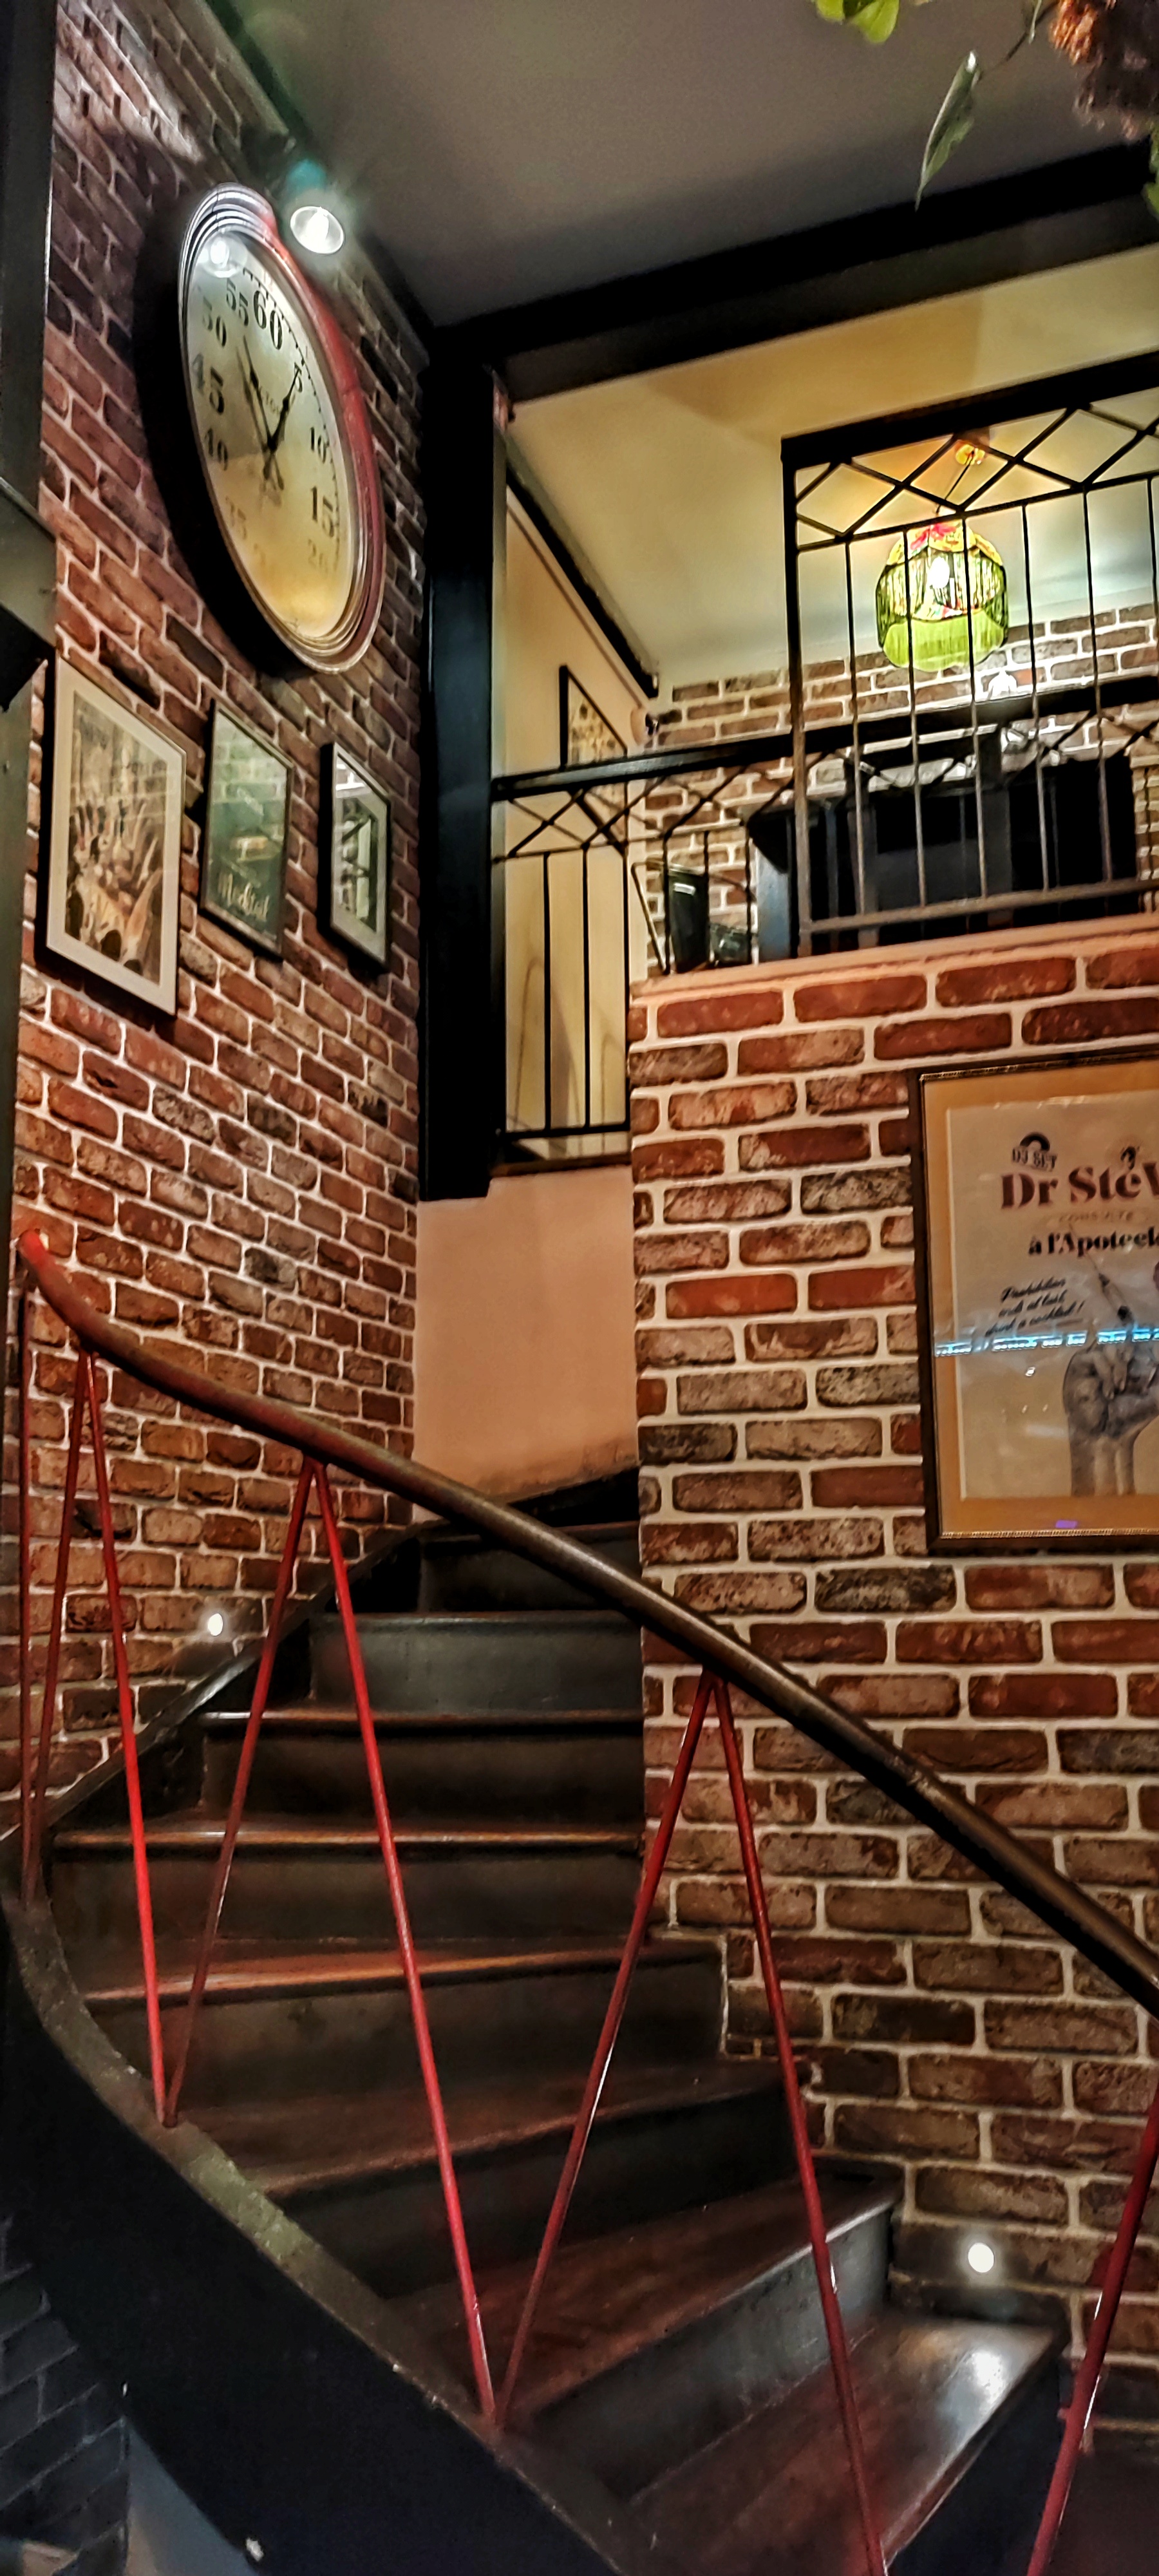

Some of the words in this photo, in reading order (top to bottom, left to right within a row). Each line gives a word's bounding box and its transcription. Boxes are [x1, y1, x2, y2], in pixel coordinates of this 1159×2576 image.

[202, 296, 227, 347] 50
[227, 279, 249, 327] 55
[254, 290, 283, 350] 60
[204, 428, 228, 471] 40
[310, 427, 327, 464] 10
[312, 486, 334, 538] 15
[1012, 1148, 1029, 1165] DJ
[1033, 1150, 1057, 1171] SET
[1001, 1173, 1059, 1209] Dr
